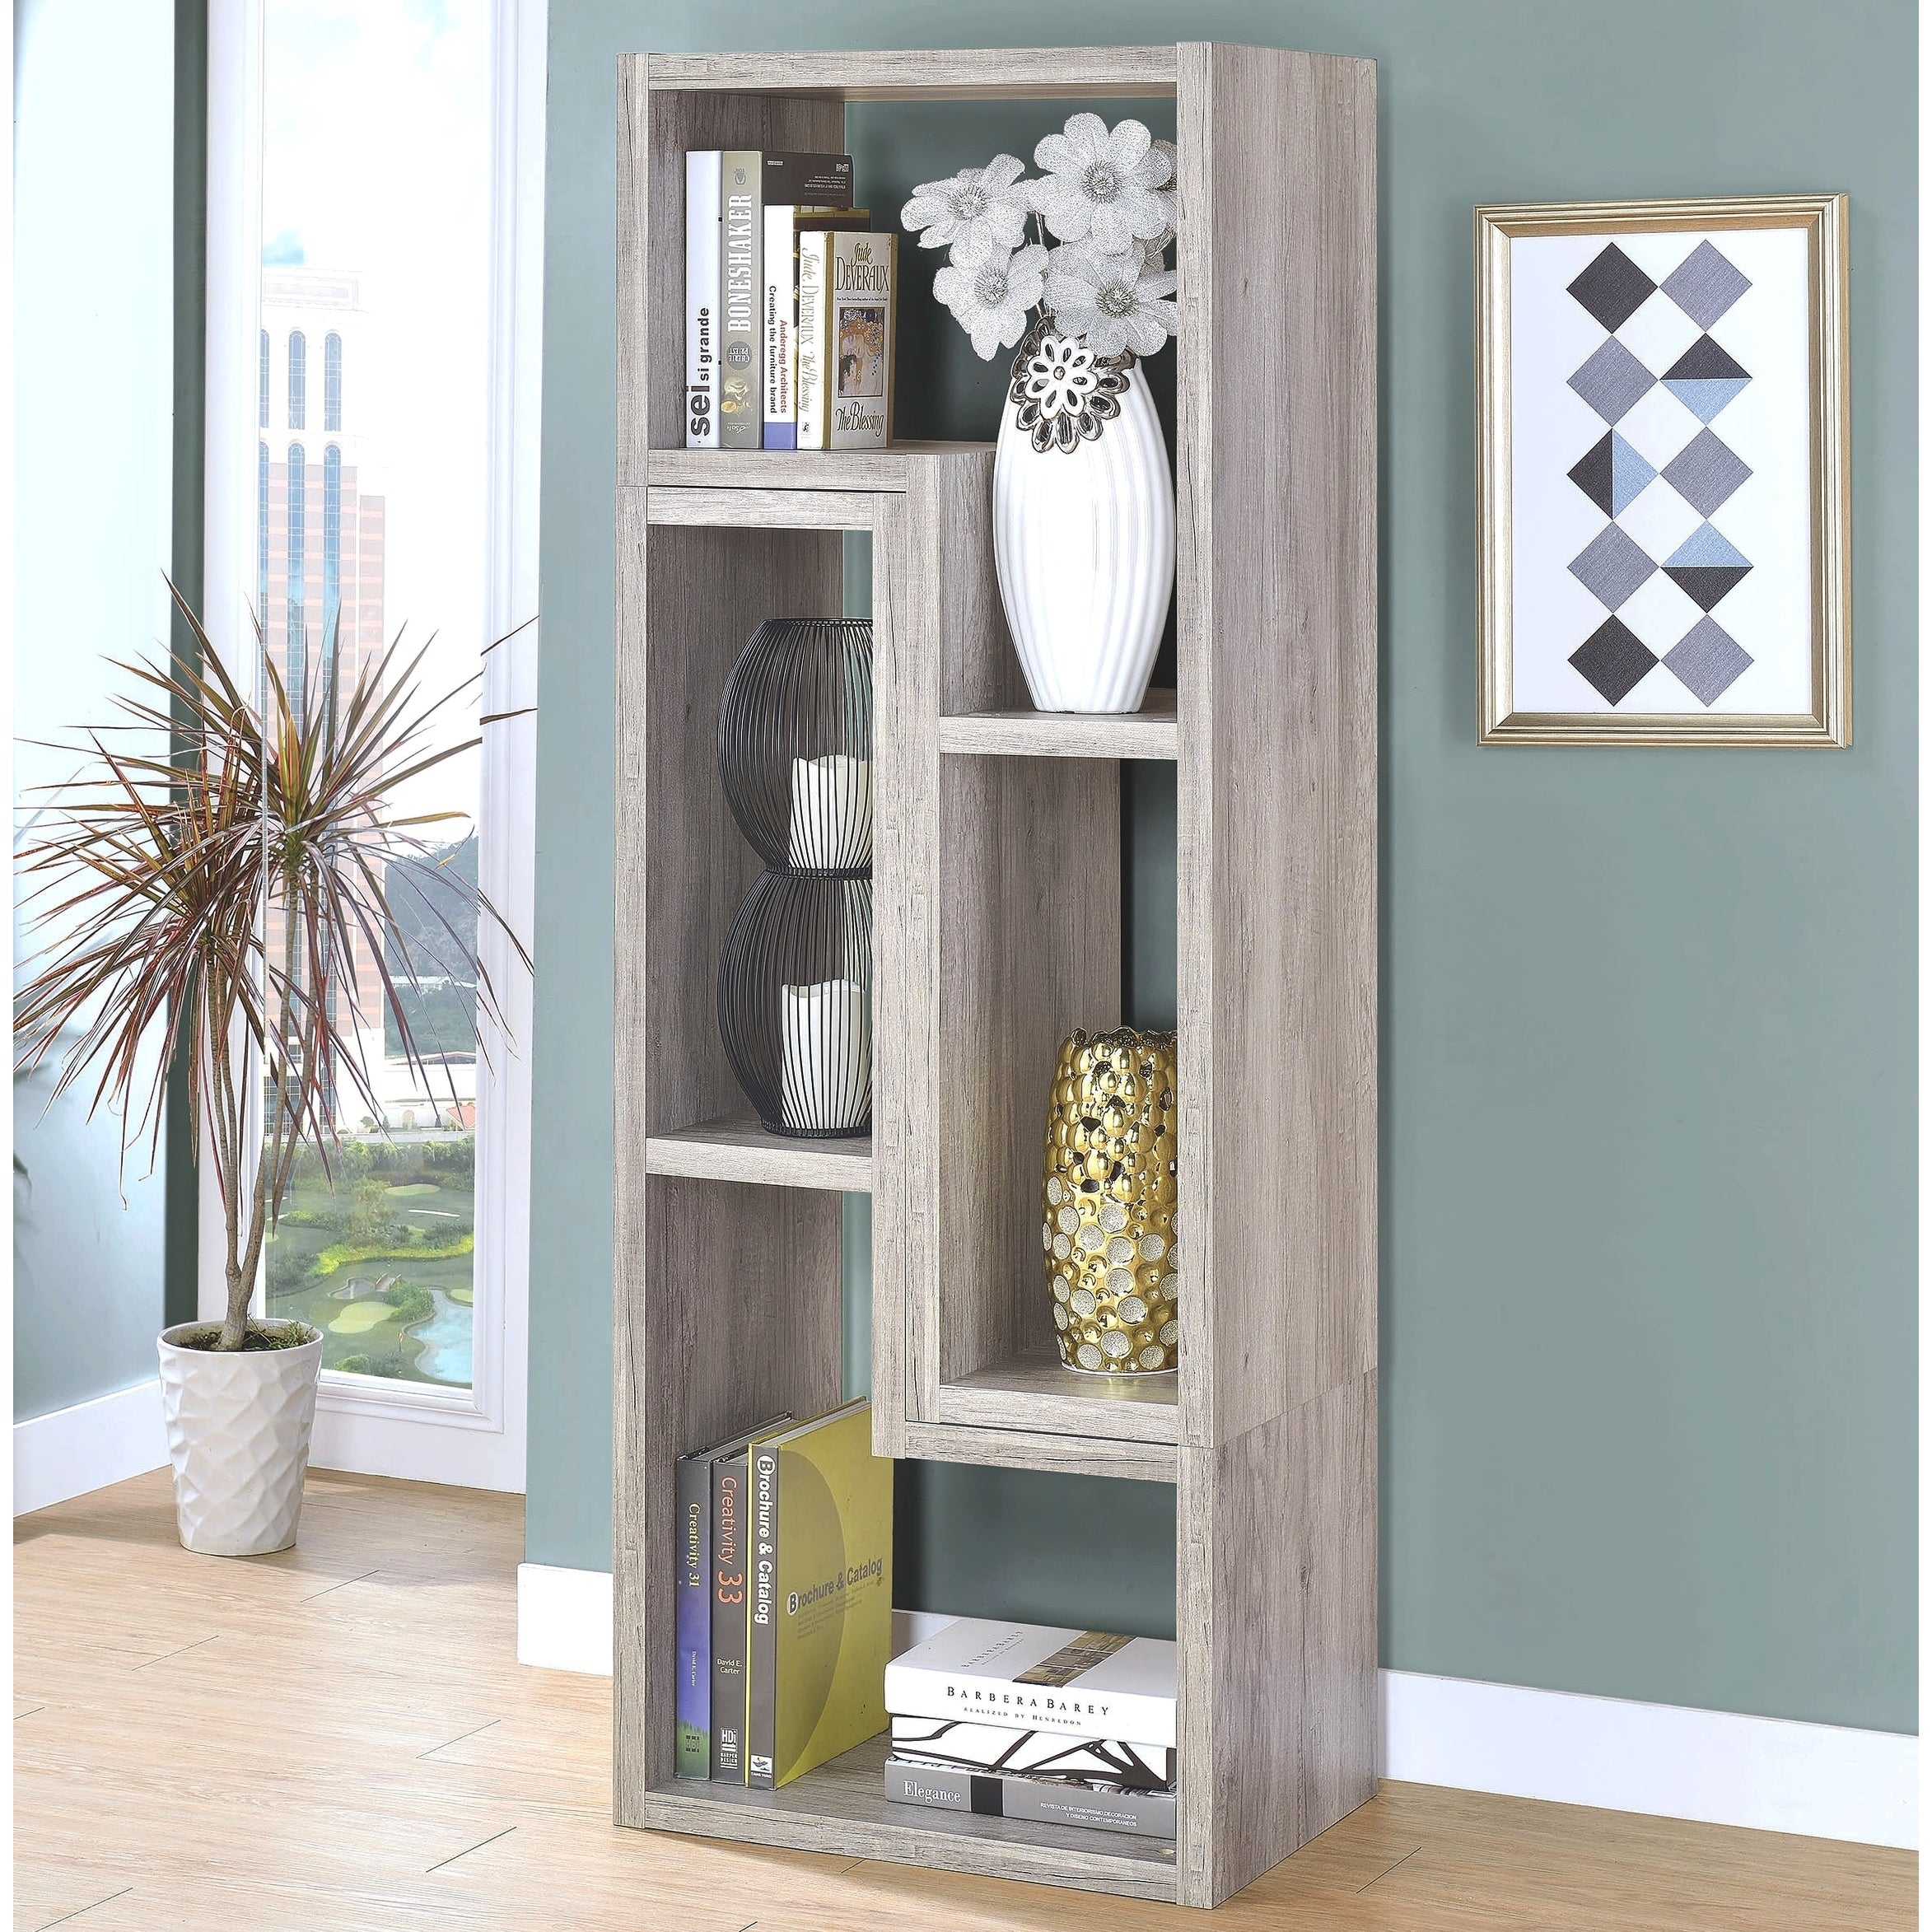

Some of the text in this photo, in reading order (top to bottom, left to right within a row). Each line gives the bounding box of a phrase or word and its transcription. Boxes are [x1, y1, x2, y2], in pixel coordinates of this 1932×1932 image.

[728, 194, 752, 333] BONESHAKER
[802, 248, 819, 282] Jude
[851, 242, 873, 267] Jude
[835, 256, 889, 293] DEVERAUX
[768, 285, 777, 324] Creating
[800, 286, 819, 344] DEVERAUX
[698, 307, 712, 363] grande
[698, 368, 709, 381] si
[729, 355, 750, 363] CHERIE
[779, 320, 788, 413] Anderegg Architects
[799, 367, 818, 412] Blessing
[835, 401, 884, 437] The Blessing
[686, 1503, 700, 1588] Creativity 31
[718, 1477, 743, 1603] Creativity 33
[754, 1455, 775, 1625] Brochure & Catalog
[787, 1581, 833, 1616] Brochure
[847, 1556, 883, 1586] Catalog
[716, 1658, 743, 1667] David E.
[720, 1667, 740, 1675] Carter
[947, 1686, 1108, 1715] BARBERA BAREY
[964, 1706, 1008, 1717] REALIZED
[1033, 1715, 1081, 1726] HENREDON
[903, 1780, 961, 1804] Elegance
[1040, 1802, 1061, 1810] REVISTA
